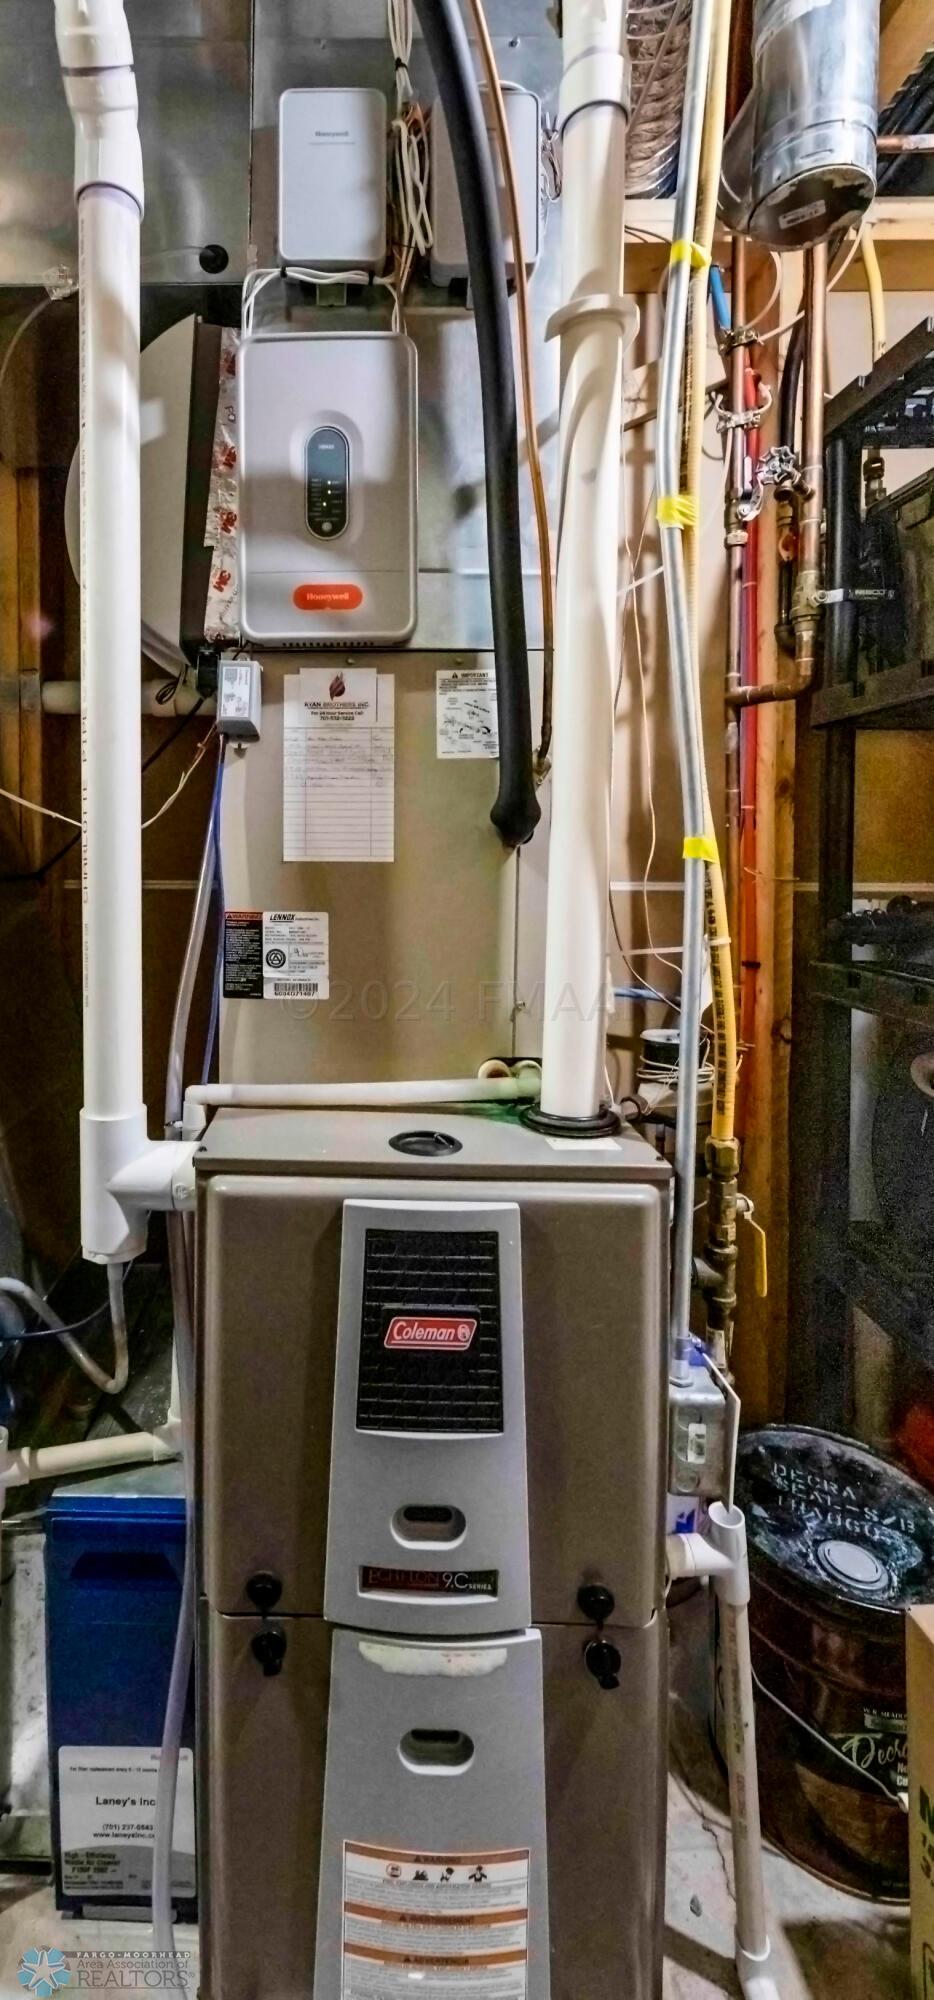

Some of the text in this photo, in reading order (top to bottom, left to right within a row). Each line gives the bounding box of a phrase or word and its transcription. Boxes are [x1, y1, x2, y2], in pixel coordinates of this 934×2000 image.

[221, 511, 238, 534] 3M
[213, 569, 232, 592] 3M
[306, 592, 350, 602] Honeywell
[269, 913, 296, 921] LENNOX
[393, 1320, 455, 1342] Coleman
[773, 1462, 857, 1500] DECRA
[96, 1796, 156, 1807] Laney's Inc
